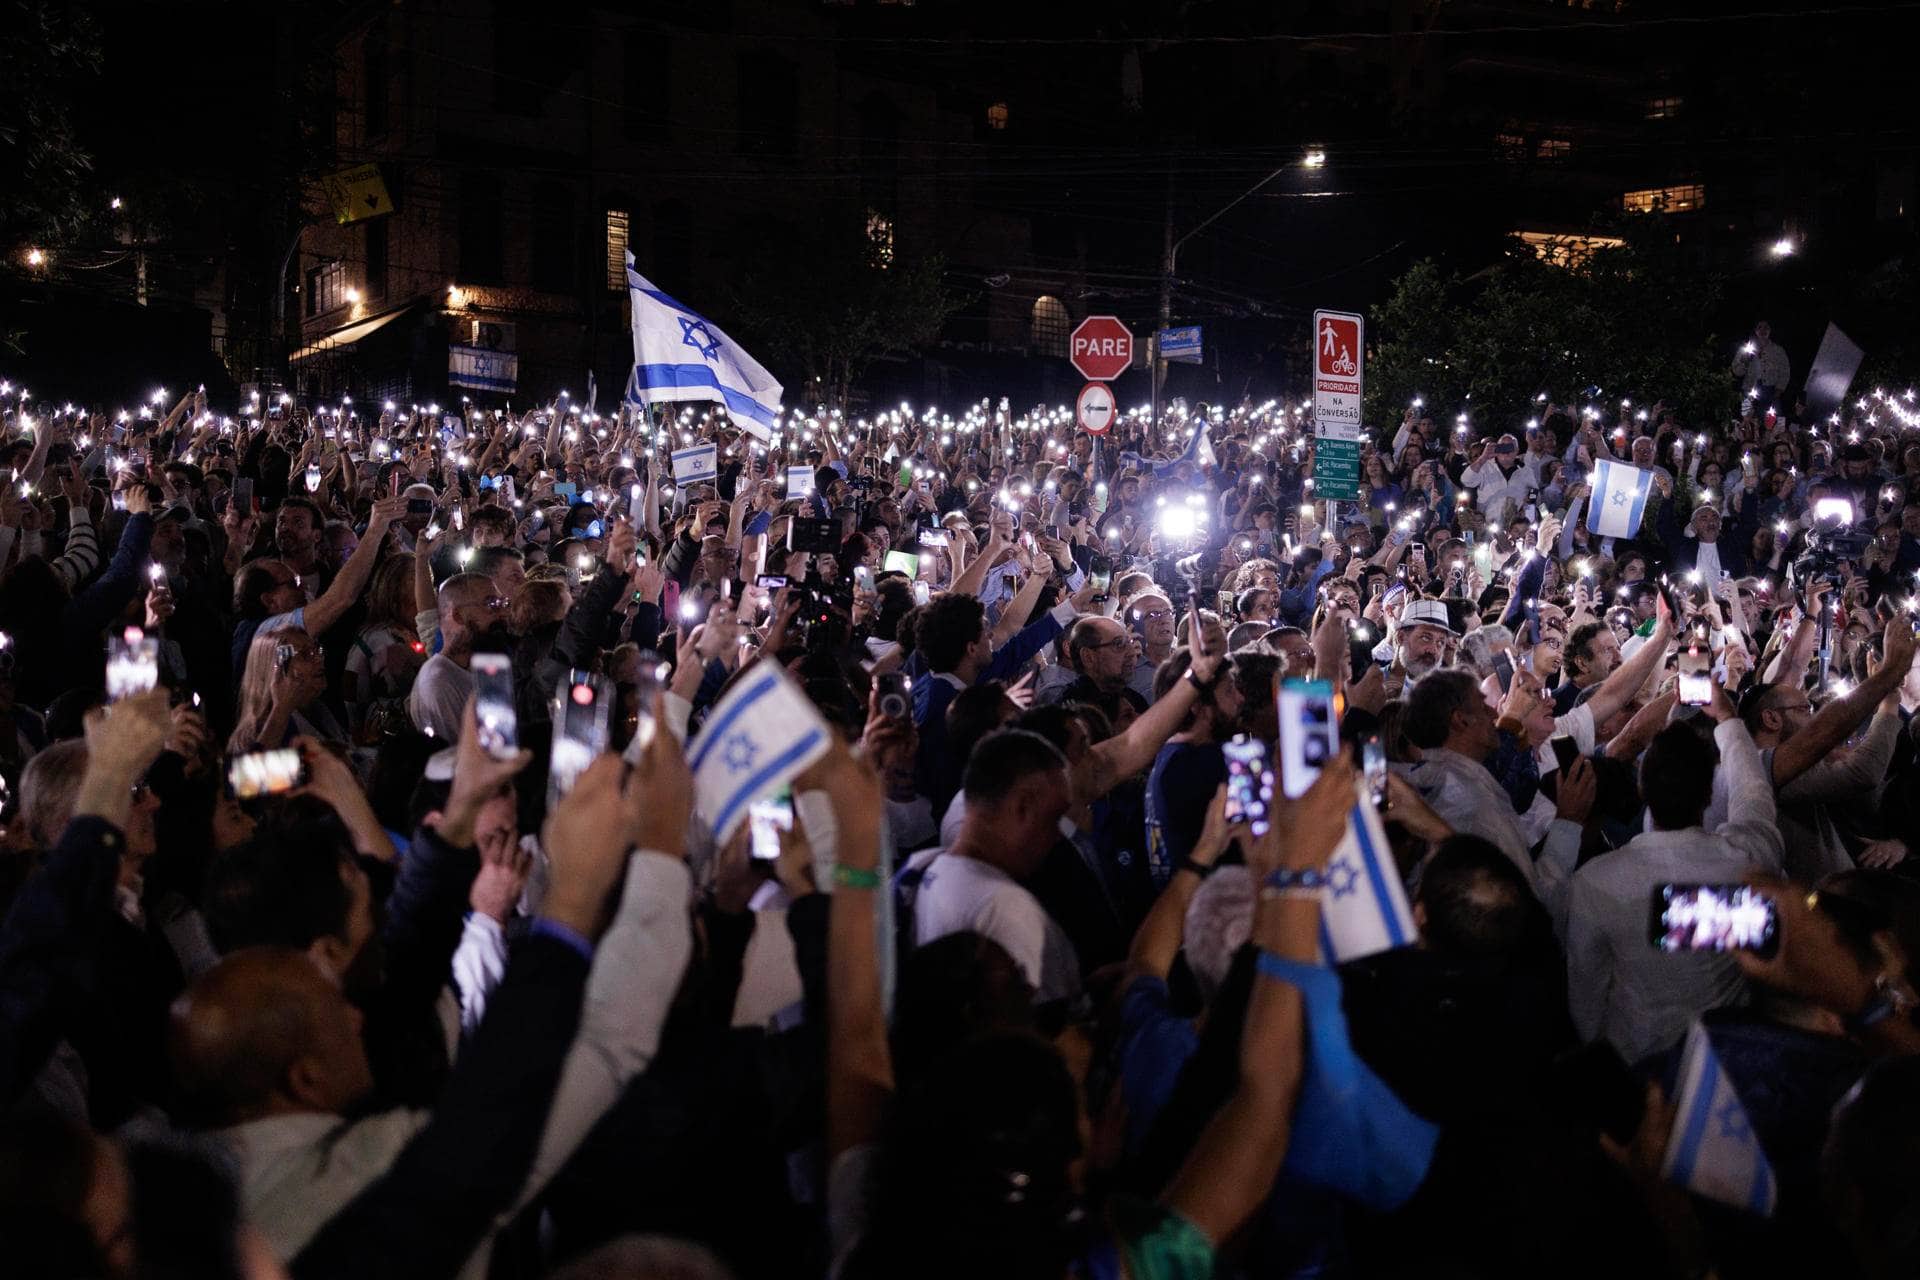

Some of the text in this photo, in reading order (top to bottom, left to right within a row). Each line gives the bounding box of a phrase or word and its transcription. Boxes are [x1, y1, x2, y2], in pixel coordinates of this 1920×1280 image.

[1074, 338, 1128, 356] PARE
[1318, 381, 1358, 393] PRIORIDADE
[1332, 397, 1343, 406] NA
[1317, 407, 1358, 419] CONVERSÃO
